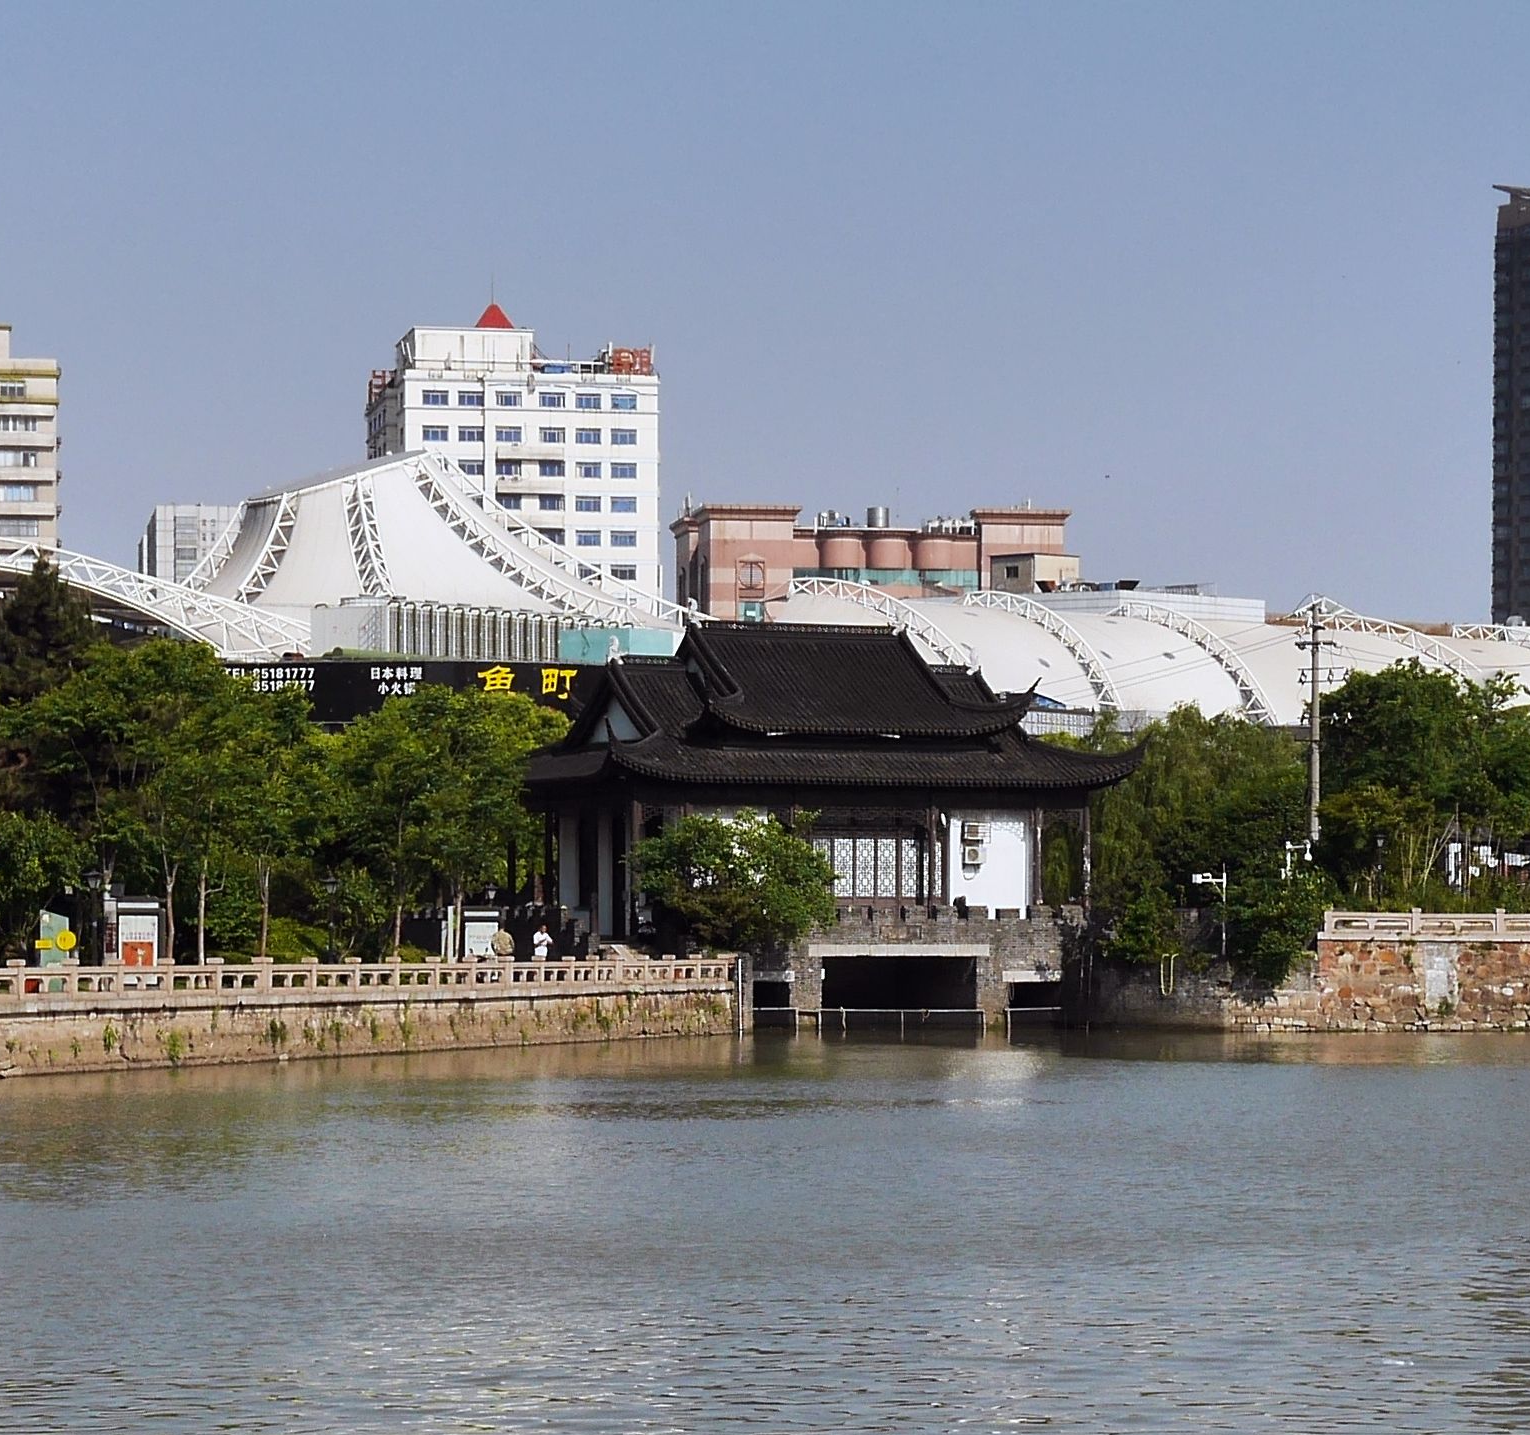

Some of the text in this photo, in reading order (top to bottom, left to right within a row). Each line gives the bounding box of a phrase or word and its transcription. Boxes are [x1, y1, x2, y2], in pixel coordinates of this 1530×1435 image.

[370, 666, 422, 680] 日本料理
[377, 681, 416, 695] 小火锅
